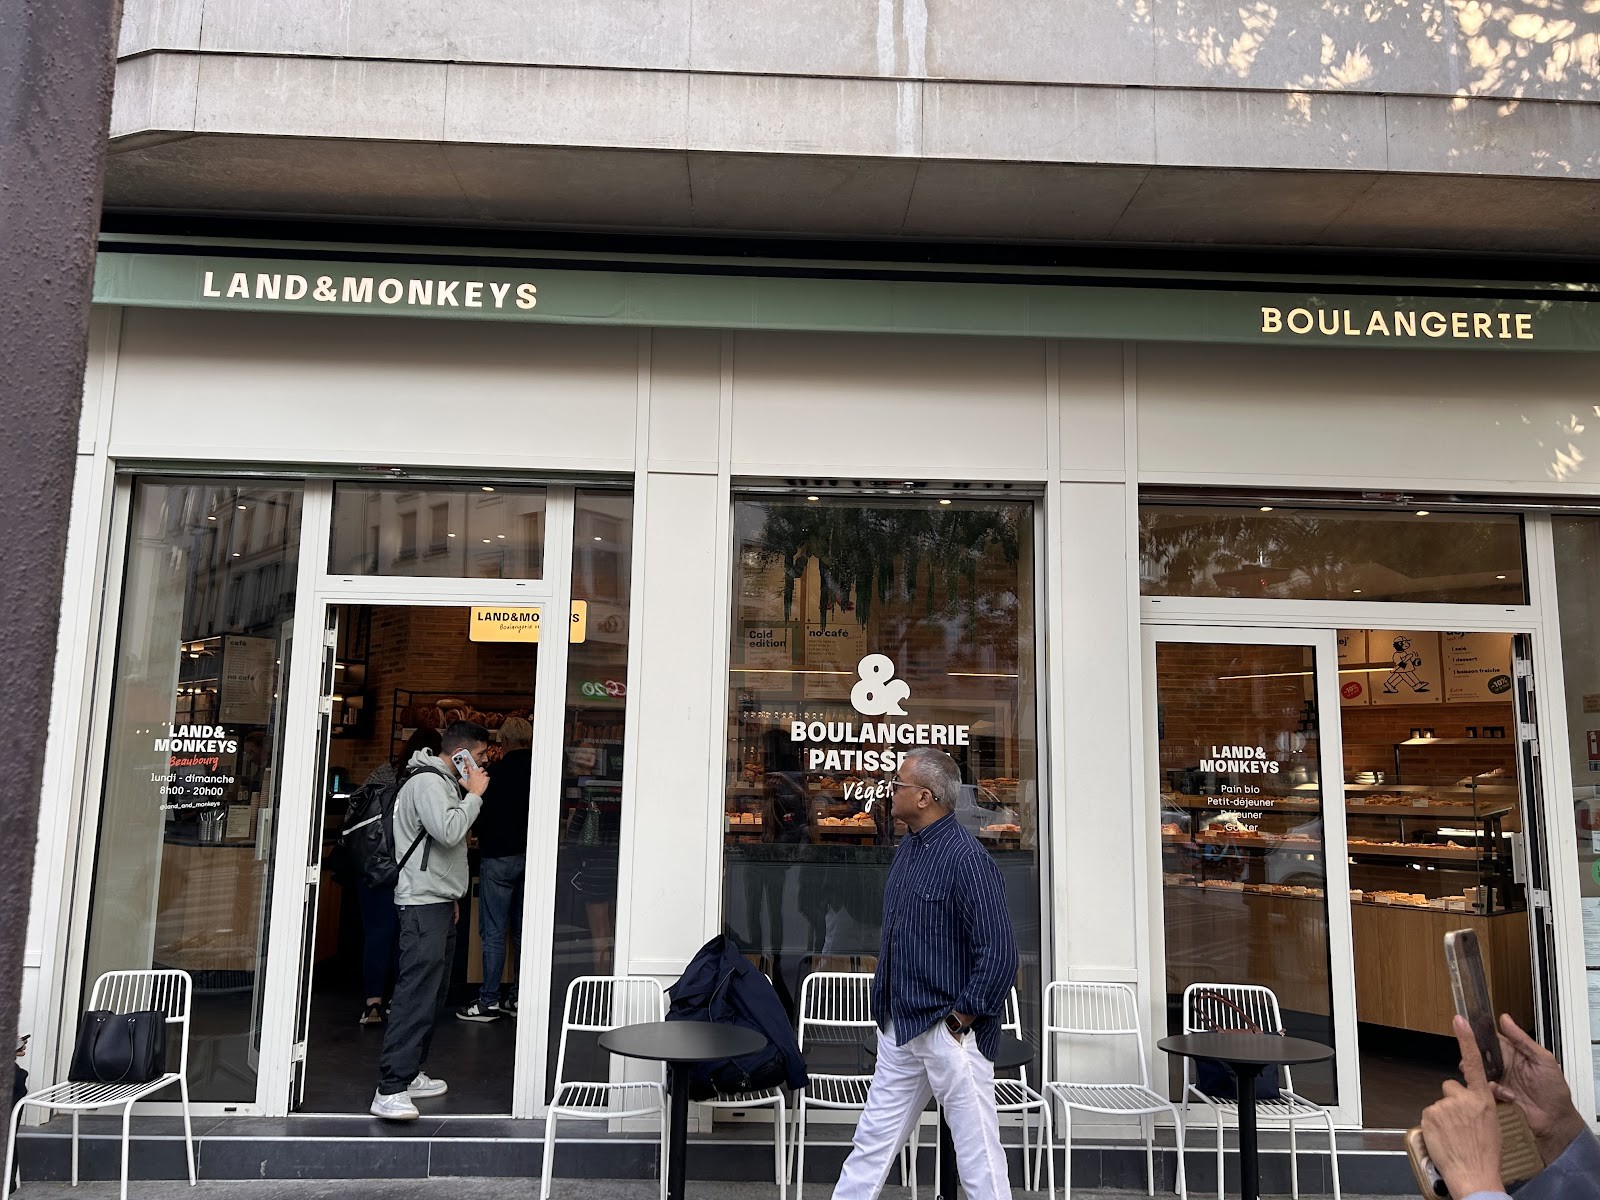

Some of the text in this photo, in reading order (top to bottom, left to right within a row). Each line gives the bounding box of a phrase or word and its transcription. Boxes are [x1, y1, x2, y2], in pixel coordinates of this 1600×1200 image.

[203, 271, 538, 309] LAND&MONKEYS
[1261, 306, 1534, 340] BOULANGERIE
[477, 611, 580, 623] LAND&MOS
[749, 630, 773, 639] Cold
[809, 628, 849, 638] no café
[749, 639, 787, 648] edition
[850, 653, 911, 716] &
[169, 724, 226, 739] LAND&
[790, 721, 970, 746] BOULANGERIE
[154, 738, 237, 753] MONKEYS
[1212, 745, 1267, 760] LAND&
[169, 754, 219, 772] Beaubourg
[809, 749, 950, 772] PATISSE
[1200, 759, 1279, 774] MONKEYS
[151, 772, 177, 783] lundi
[185, 773, 235, 784] dimanche
[159, 786, 184, 795] 8h00
[192, 786, 224, 796] 20h00
[843, 779, 894, 813] Végét
[1221, 784, 1260, 794] Pain bio
[159, 800, 221, 811] @land_and_monkeys
[1207, 796, 1275, 809] Petit-déjeuner
